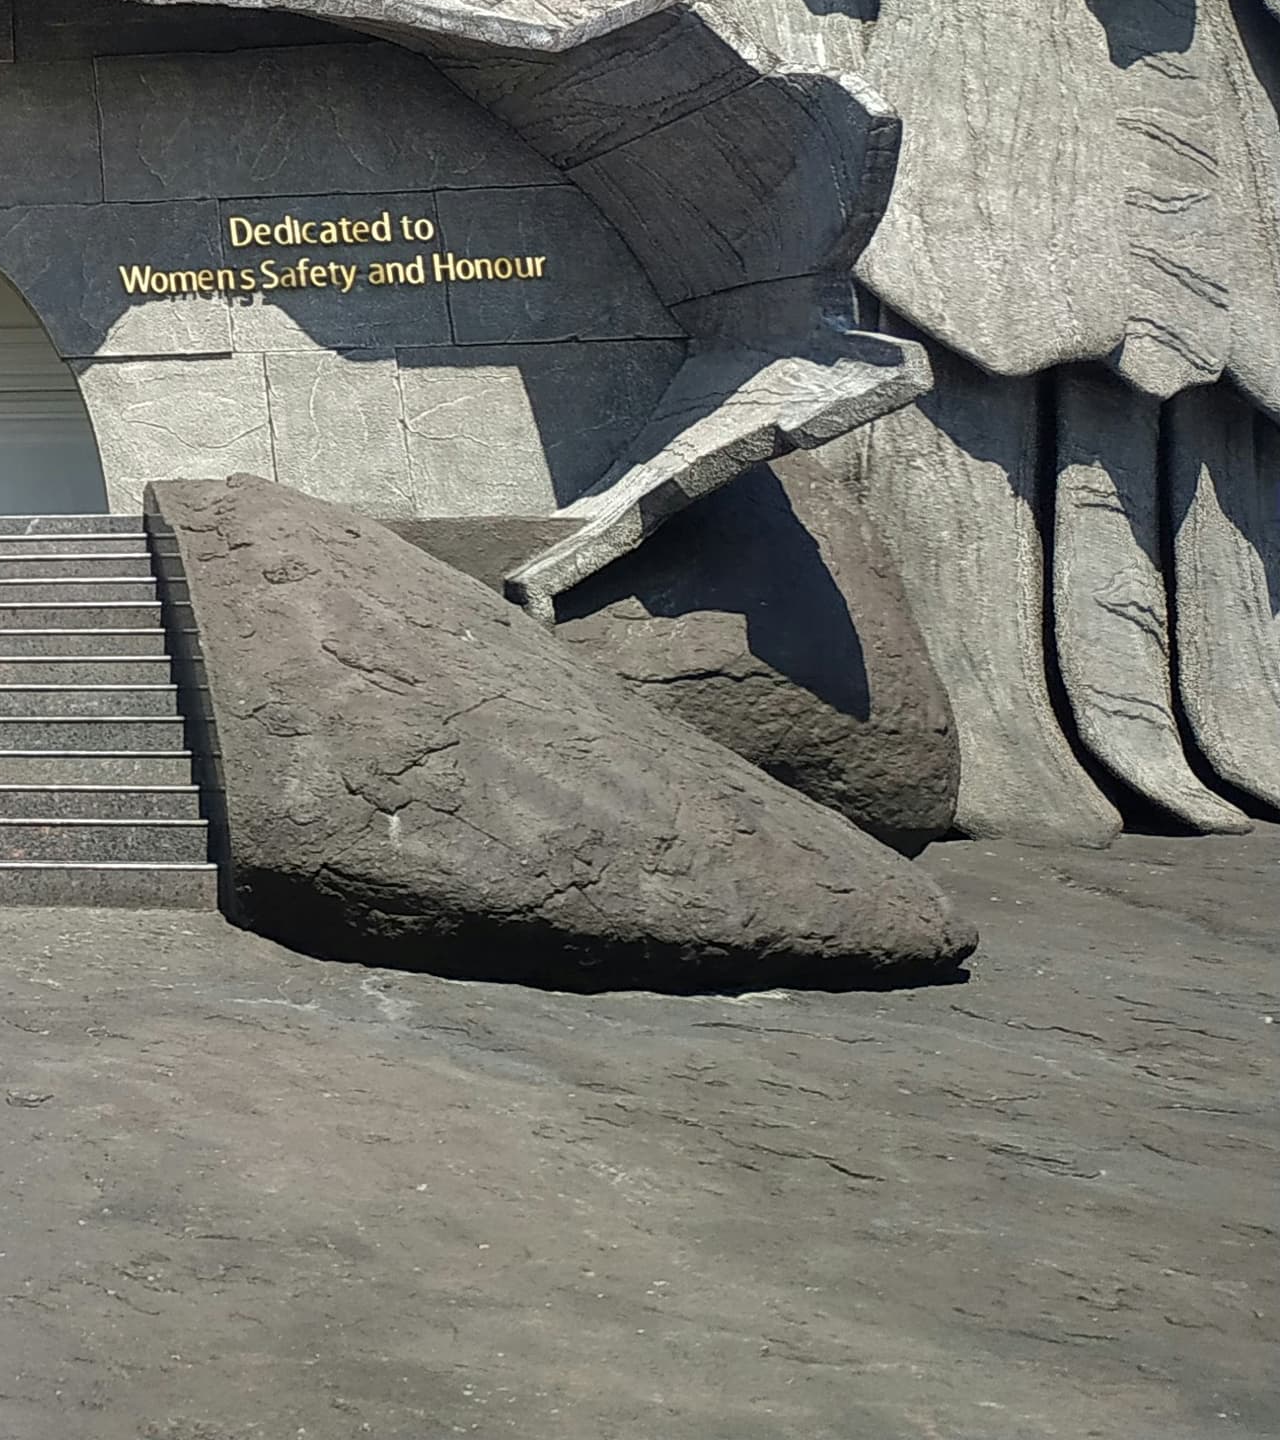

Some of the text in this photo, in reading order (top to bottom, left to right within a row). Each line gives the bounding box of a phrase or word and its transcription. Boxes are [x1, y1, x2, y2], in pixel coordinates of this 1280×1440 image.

[228, 212, 434, 248] Dedicated to
[260, 258, 358, 293] Safety
[368, 255, 425, 285] and
[432, 252, 546, 283] Honour
